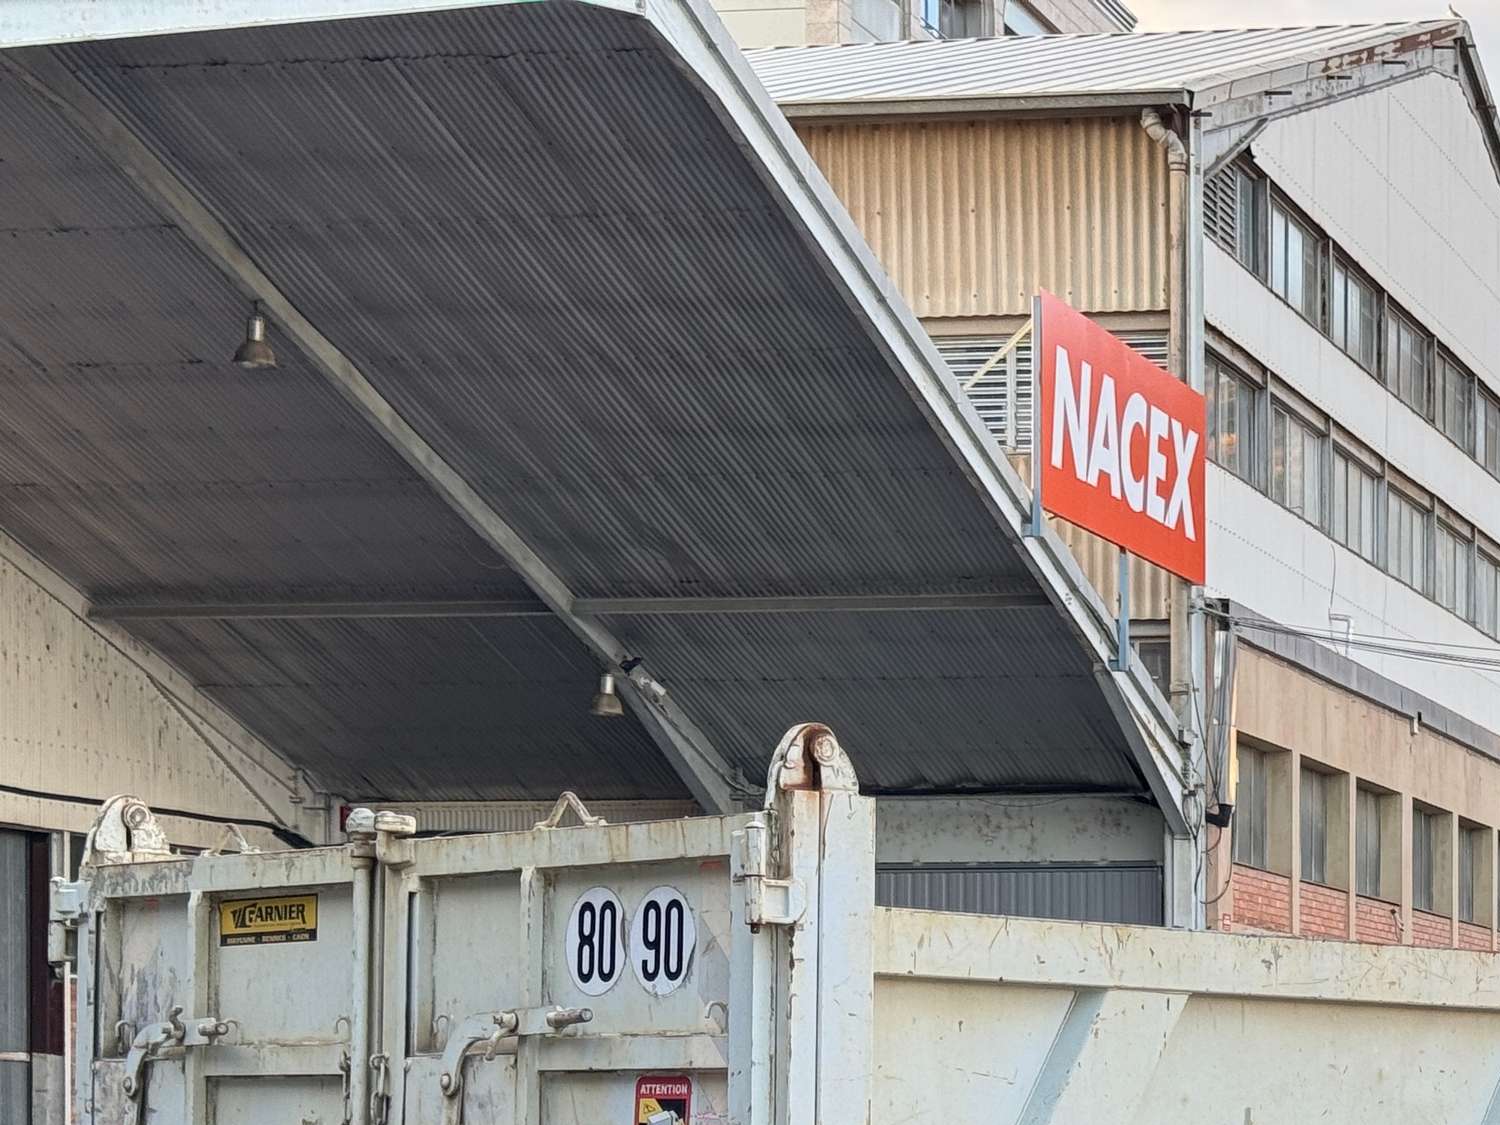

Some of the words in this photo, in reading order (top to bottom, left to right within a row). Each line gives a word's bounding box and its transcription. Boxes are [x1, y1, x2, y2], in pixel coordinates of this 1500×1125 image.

[1051, 344, 1199, 541] NACEX
[578, 900, 616, 983] 80
[642, 899, 684, 981] 90
[640, 1084, 688, 1095] ATTENTION
